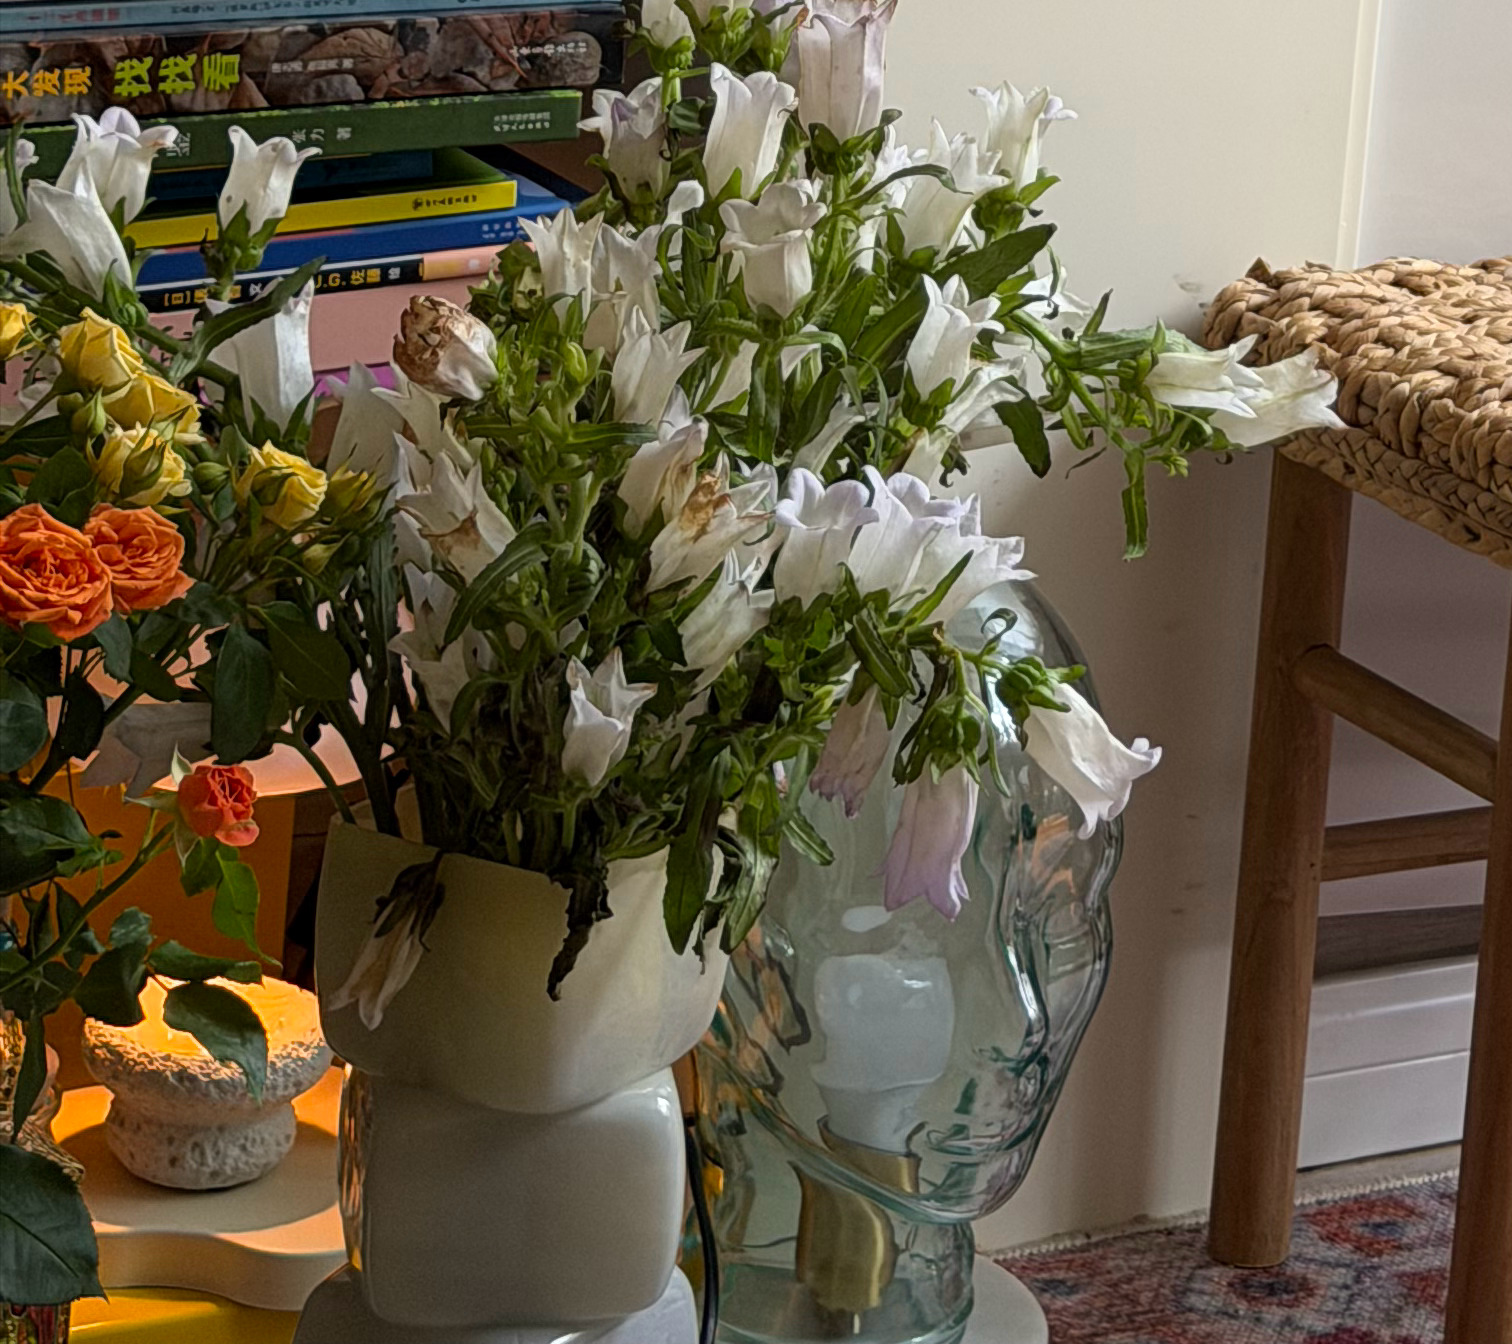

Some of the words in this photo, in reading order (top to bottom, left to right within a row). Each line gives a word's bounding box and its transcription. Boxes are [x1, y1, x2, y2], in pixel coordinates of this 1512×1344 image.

[2, 65, 92, 99] 大发现
[113, 53, 241, 97] 找找看
[292, 127, 326, 144] 张力
[315, 273, 347, 289] J.G.
